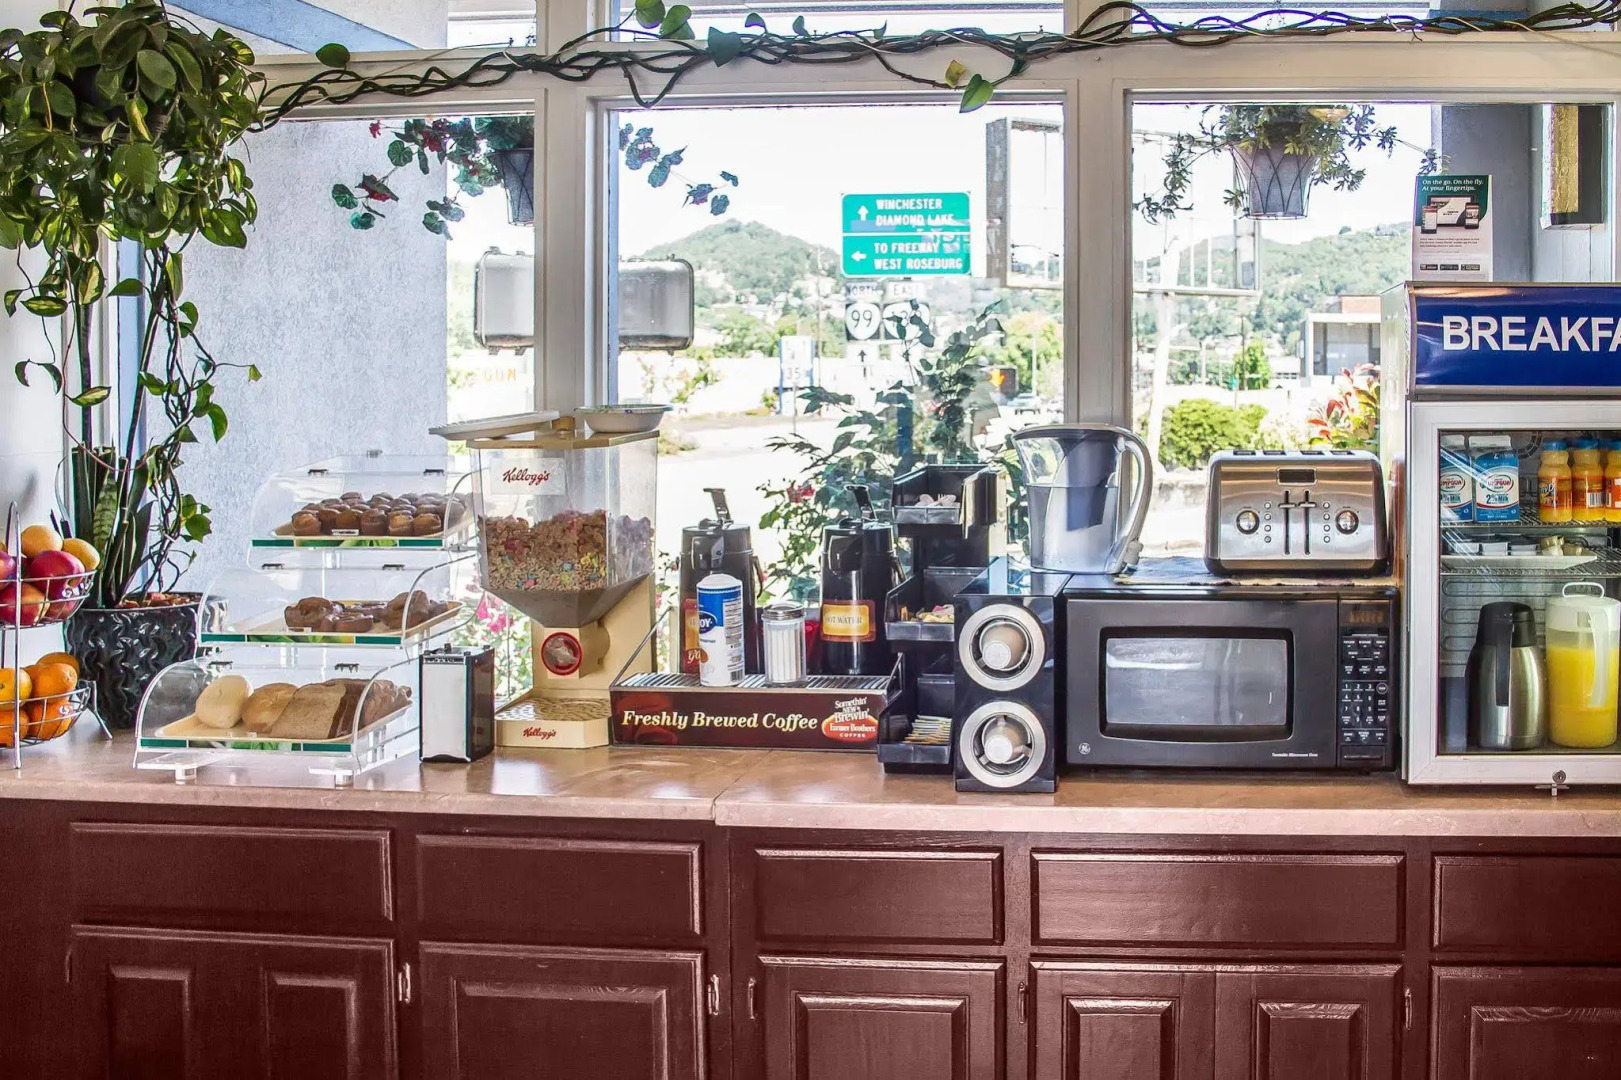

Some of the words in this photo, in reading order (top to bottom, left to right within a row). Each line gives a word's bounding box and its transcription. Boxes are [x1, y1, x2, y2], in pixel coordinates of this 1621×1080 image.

[876, 198, 942, 210] WINCHESTER
[876, 214, 925, 226] DIAMOND
[927, 214, 954, 226] LAKE
[874, 243, 888, 254] TO
[891, 242, 940, 254] FREEWAY
[874, 259, 902, 270] WEST
[906, 258, 963, 270] ROSEBURG
[852, 310, 872, 328] 99
[503, 467, 550, 486] Kellogg's
[837, 616, 862, 624] WATER
[835, 697, 867, 709] Somethin'
[834, 706, 870, 723] Brewin'
[621, 710, 689, 730] Freshly
[691, 712, 758, 728] Brewed
[762, 713, 818, 732] Coffee
[523, 727, 557, 740] Kellogg's
[850, 724, 876, 732] Brothers
